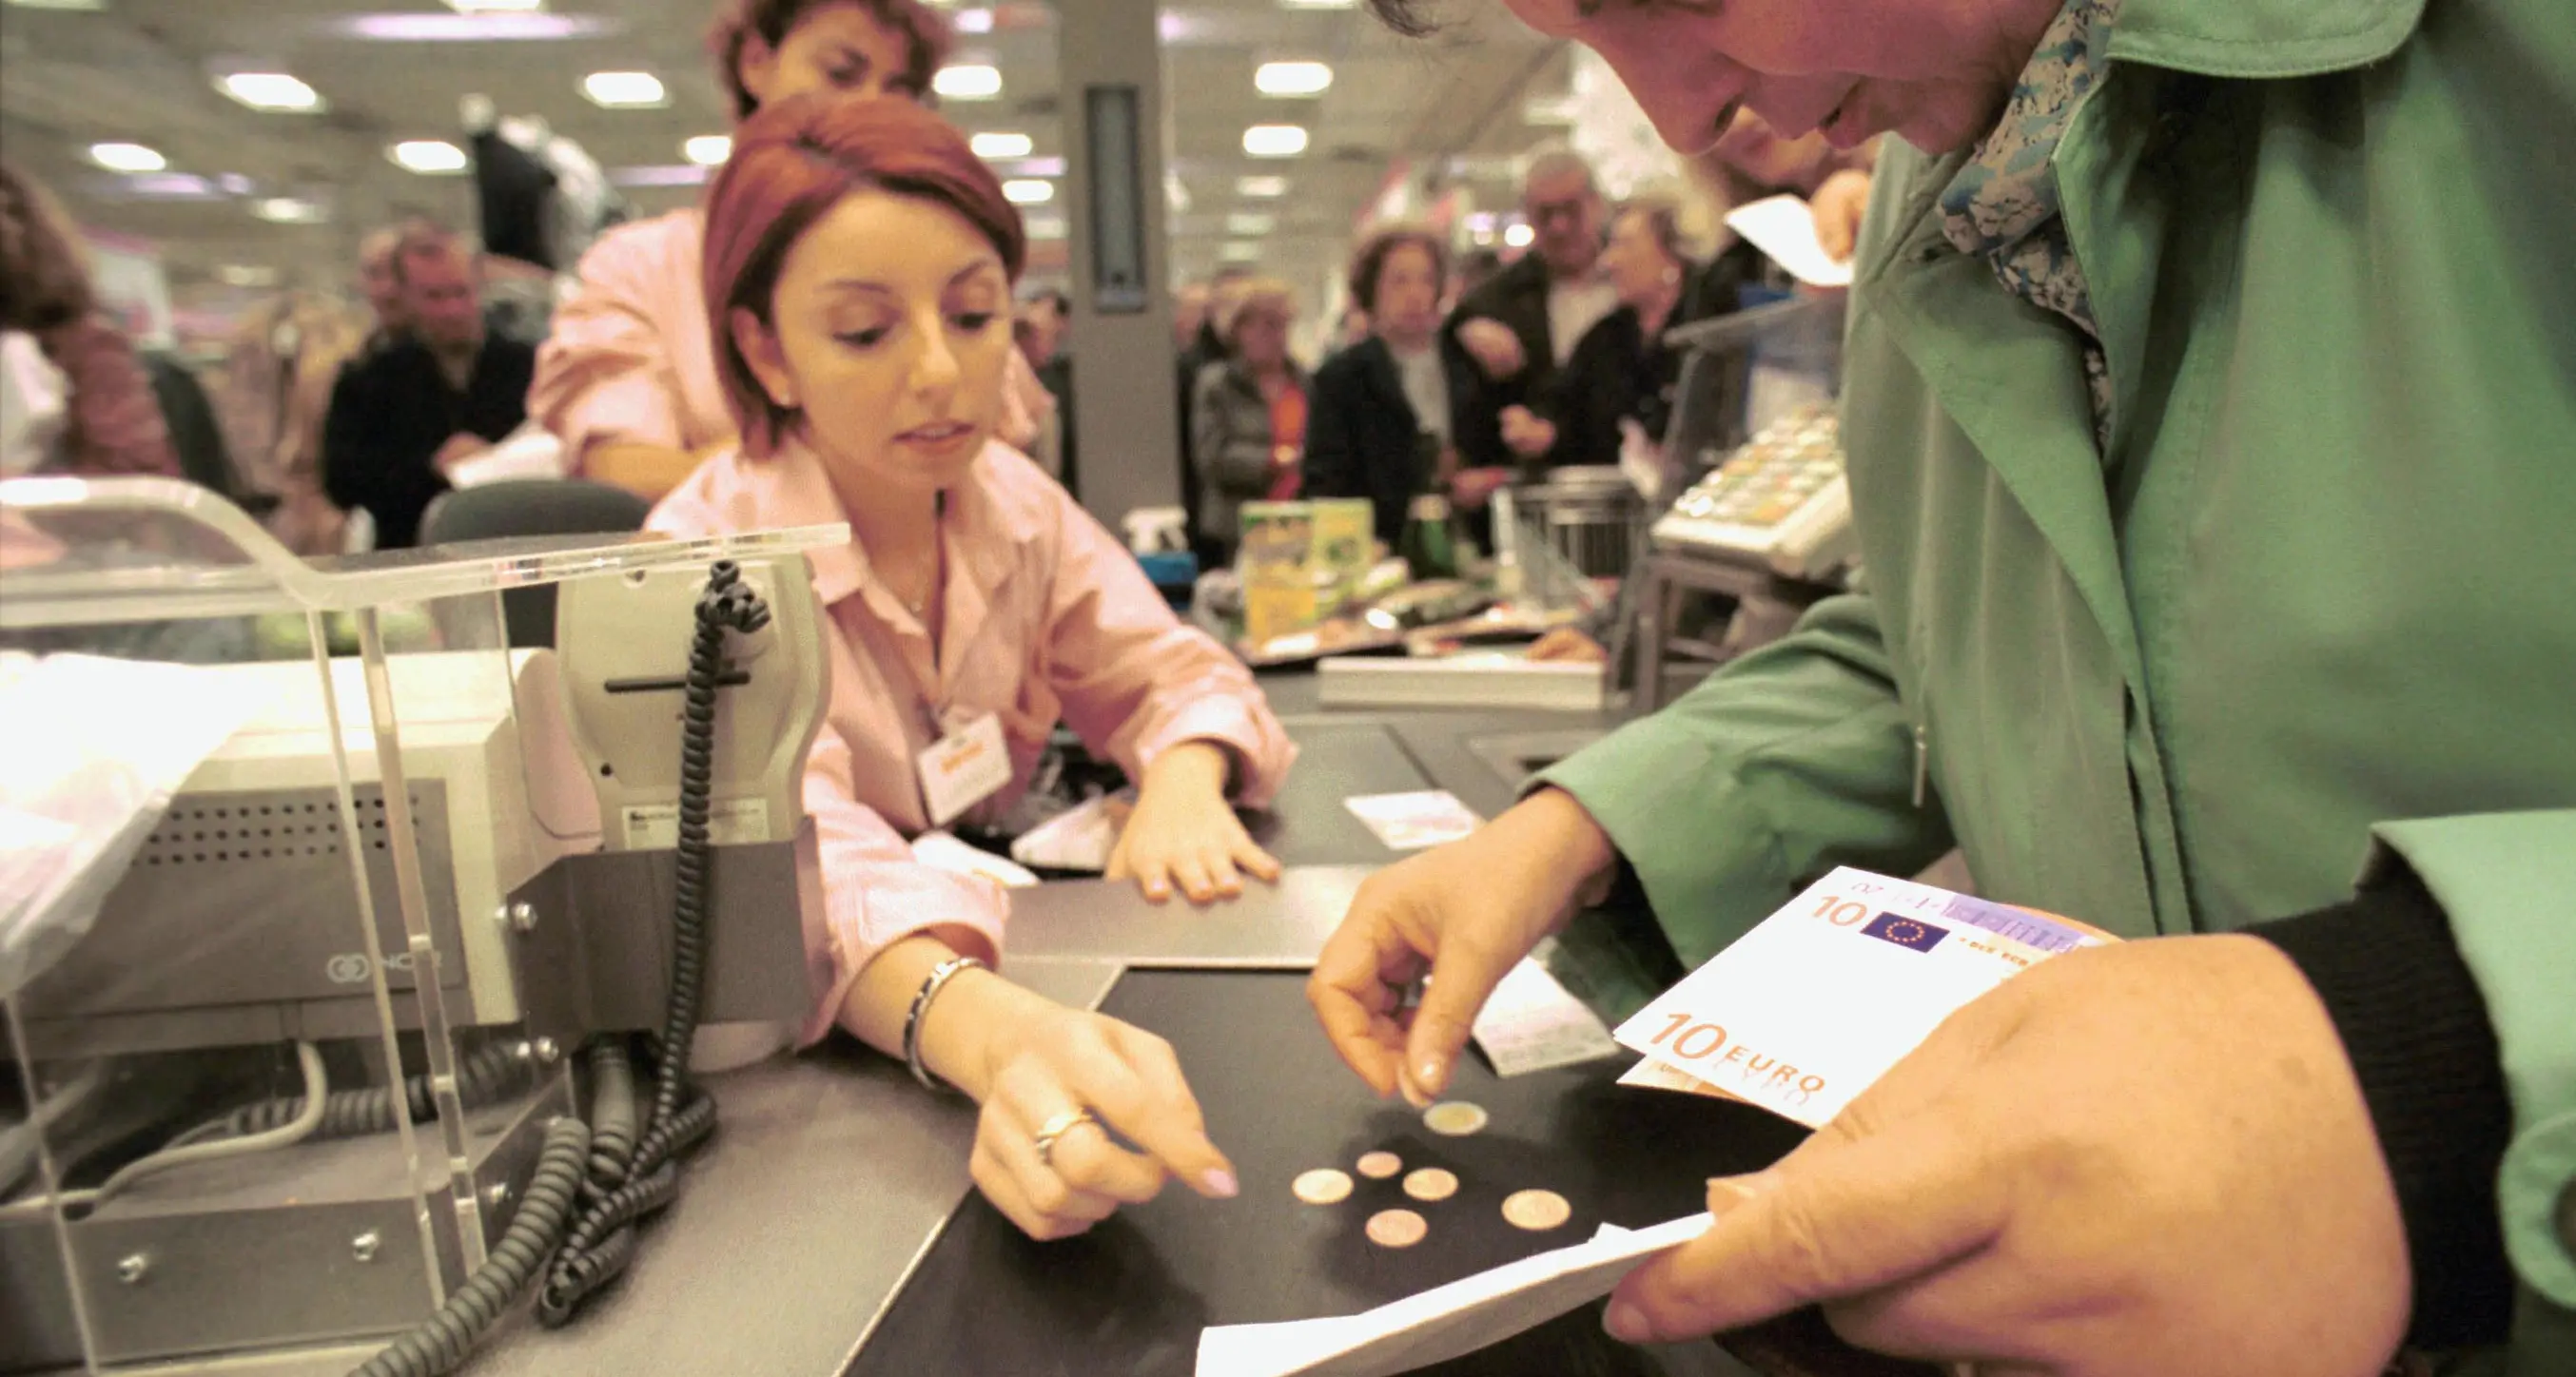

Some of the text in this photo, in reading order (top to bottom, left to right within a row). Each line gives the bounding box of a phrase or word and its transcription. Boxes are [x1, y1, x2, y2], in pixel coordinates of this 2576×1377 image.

[1812, 895, 1867, 926] 10
[379, 953, 442, 971] NC
[1649, 1013, 1727, 1059] 10
[1723, 1045, 1825, 1093] EURO
